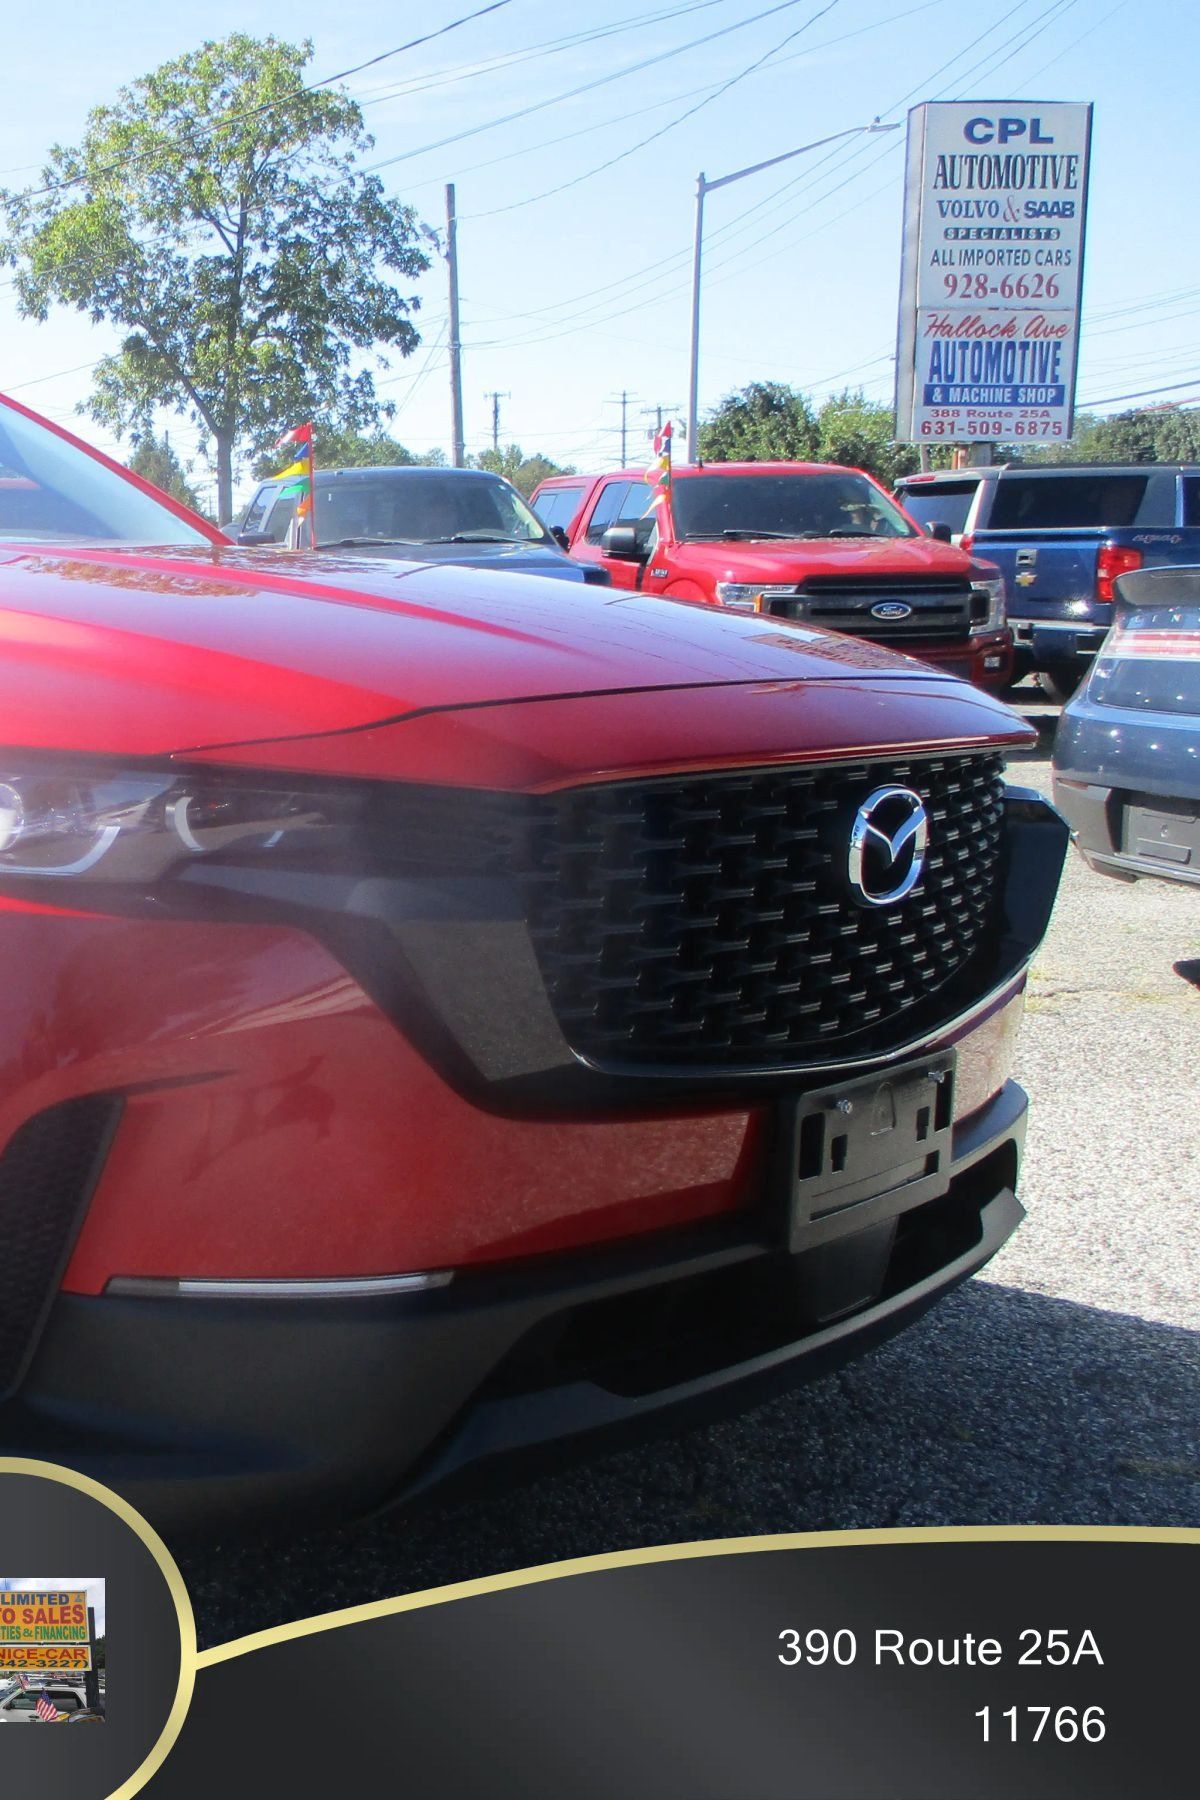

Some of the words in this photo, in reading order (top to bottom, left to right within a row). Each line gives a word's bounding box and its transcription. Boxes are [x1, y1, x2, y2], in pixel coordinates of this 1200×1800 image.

[963, 117, 1054, 144] CPL
[933, 154, 1079, 189] AUTOMOTIVE
[936, 200, 1000, 218] VOLVO
[1003, 195, 1020, 222] &
[1024, 201, 1075, 219] SAAB
[946, 228, 1059, 240] SPECIALISTS
[930, 249, 955, 266] ALL
[958, 249, 1031, 266] IMPORTED
[1035, 249, 1071, 266] CARS
[944, 273, 1060, 299] 928-6626
[923, 314, 1020, 339] Hallock
[1024, 314, 1071, 339] Ave
[928, 341, 1062, 384] AUTOMOTIVE
[932, 387, 943, 402] &
[949, 387, 1013, 403] MACHINE
[1017, 387, 1057, 403] SHOP
[930, 409, 961, 419] 388
[966, 409, 1014, 419] Route
[1019, 409, 1051, 419] 25A
[921, 421, 1063, 436] 631-509-6875
